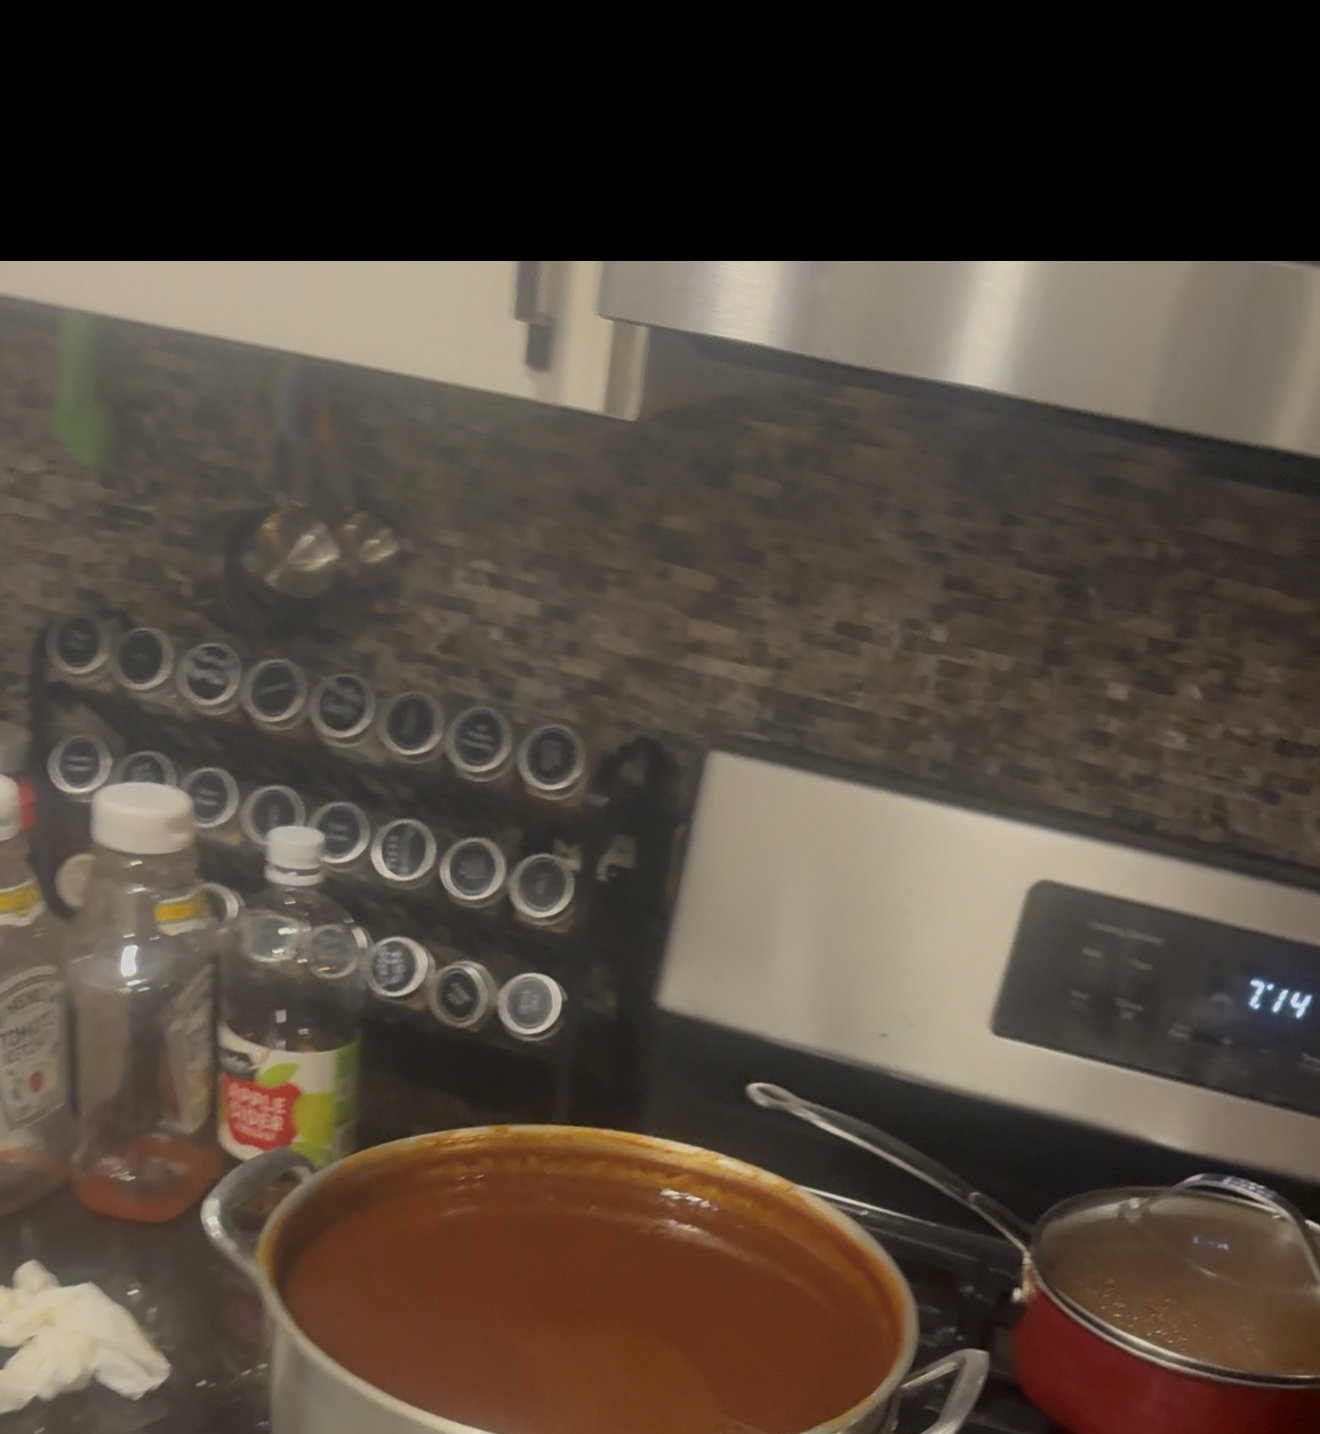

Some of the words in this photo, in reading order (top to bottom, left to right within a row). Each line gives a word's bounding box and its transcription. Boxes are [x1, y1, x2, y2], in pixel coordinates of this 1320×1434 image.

[1250, 978, 1312, 1018] 7:14
[227, 1082, 286, 1114] APPLE
[229, 1097, 283, 1131] CIDER
